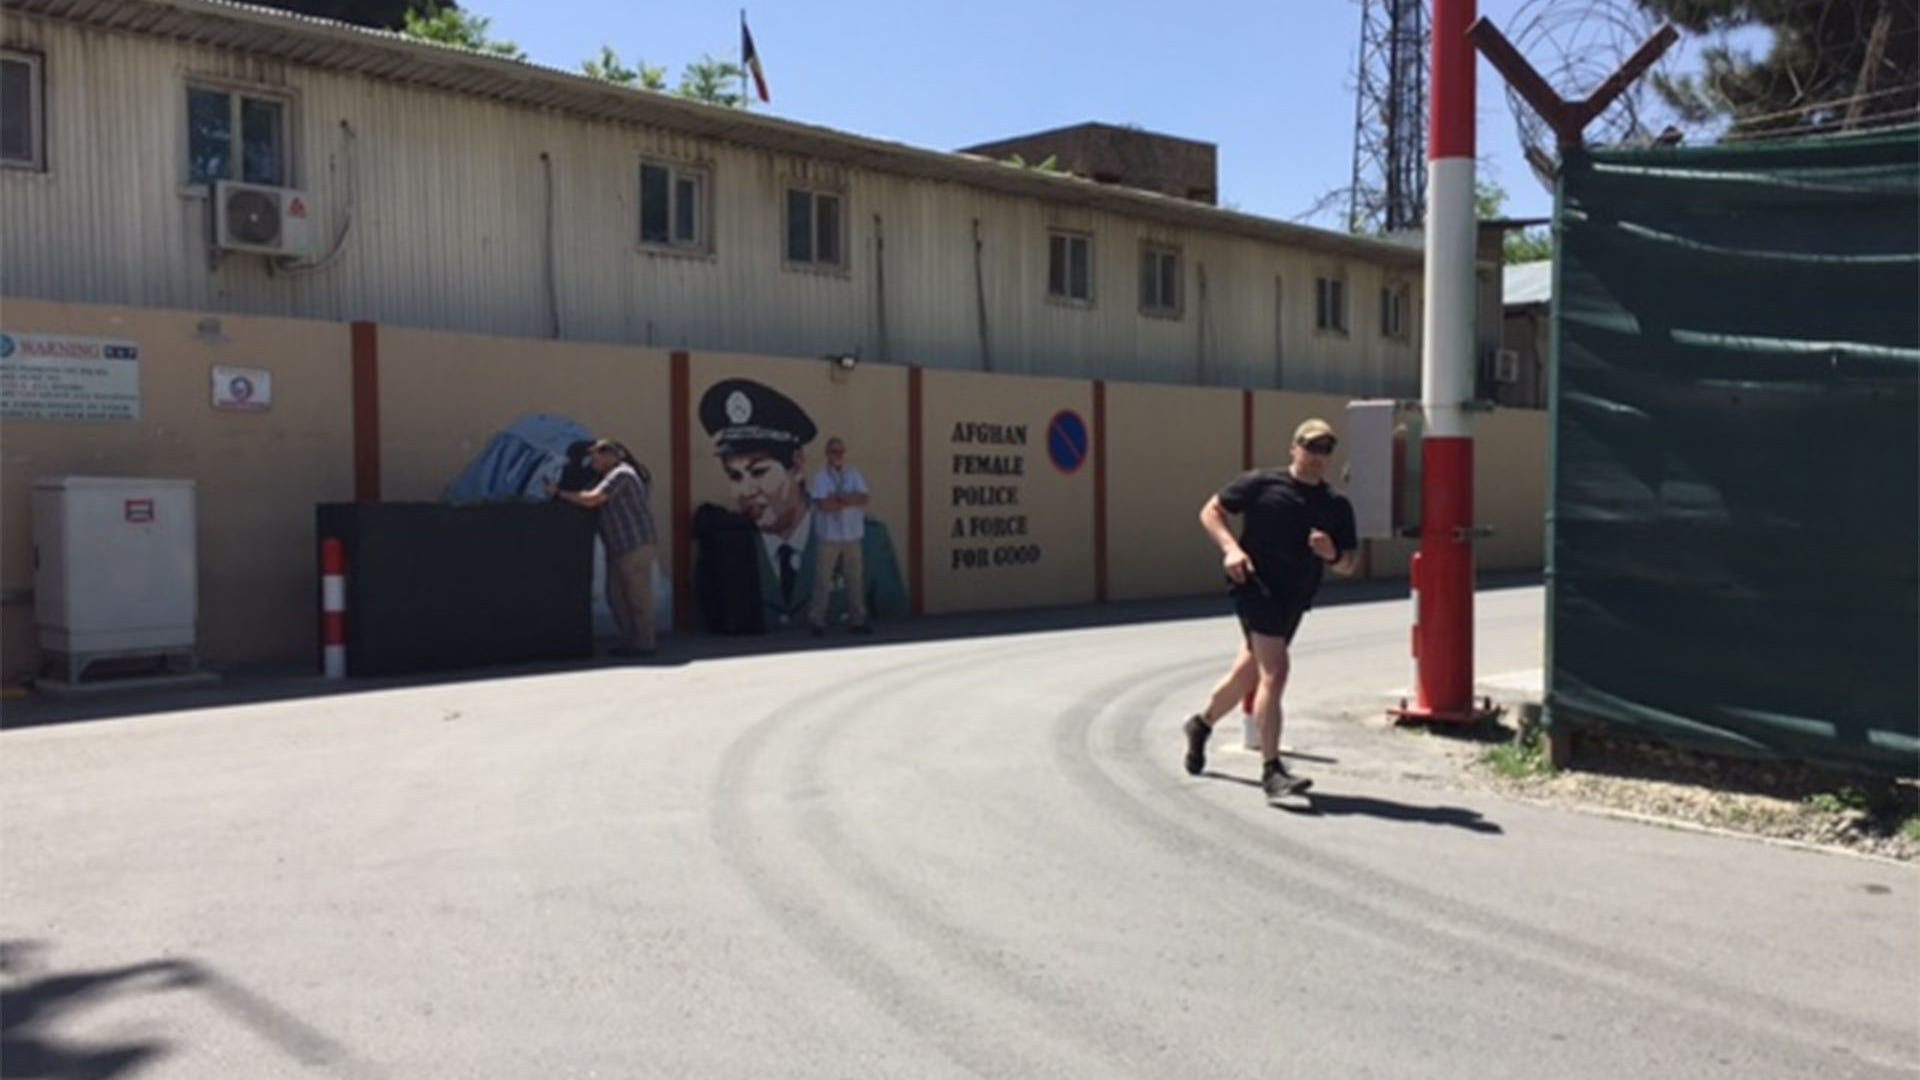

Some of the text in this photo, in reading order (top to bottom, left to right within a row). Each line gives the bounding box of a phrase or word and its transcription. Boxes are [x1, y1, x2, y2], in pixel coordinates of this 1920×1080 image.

[952, 422, 1027, 445] AFGHAN
[953, 454, 1024, 476] FEMALE
[952, 486, 1017, 506] POLICE
[952, 516, 1027, 537] A FORCE
[952, 544, 1041, 570] FOR GOOD
